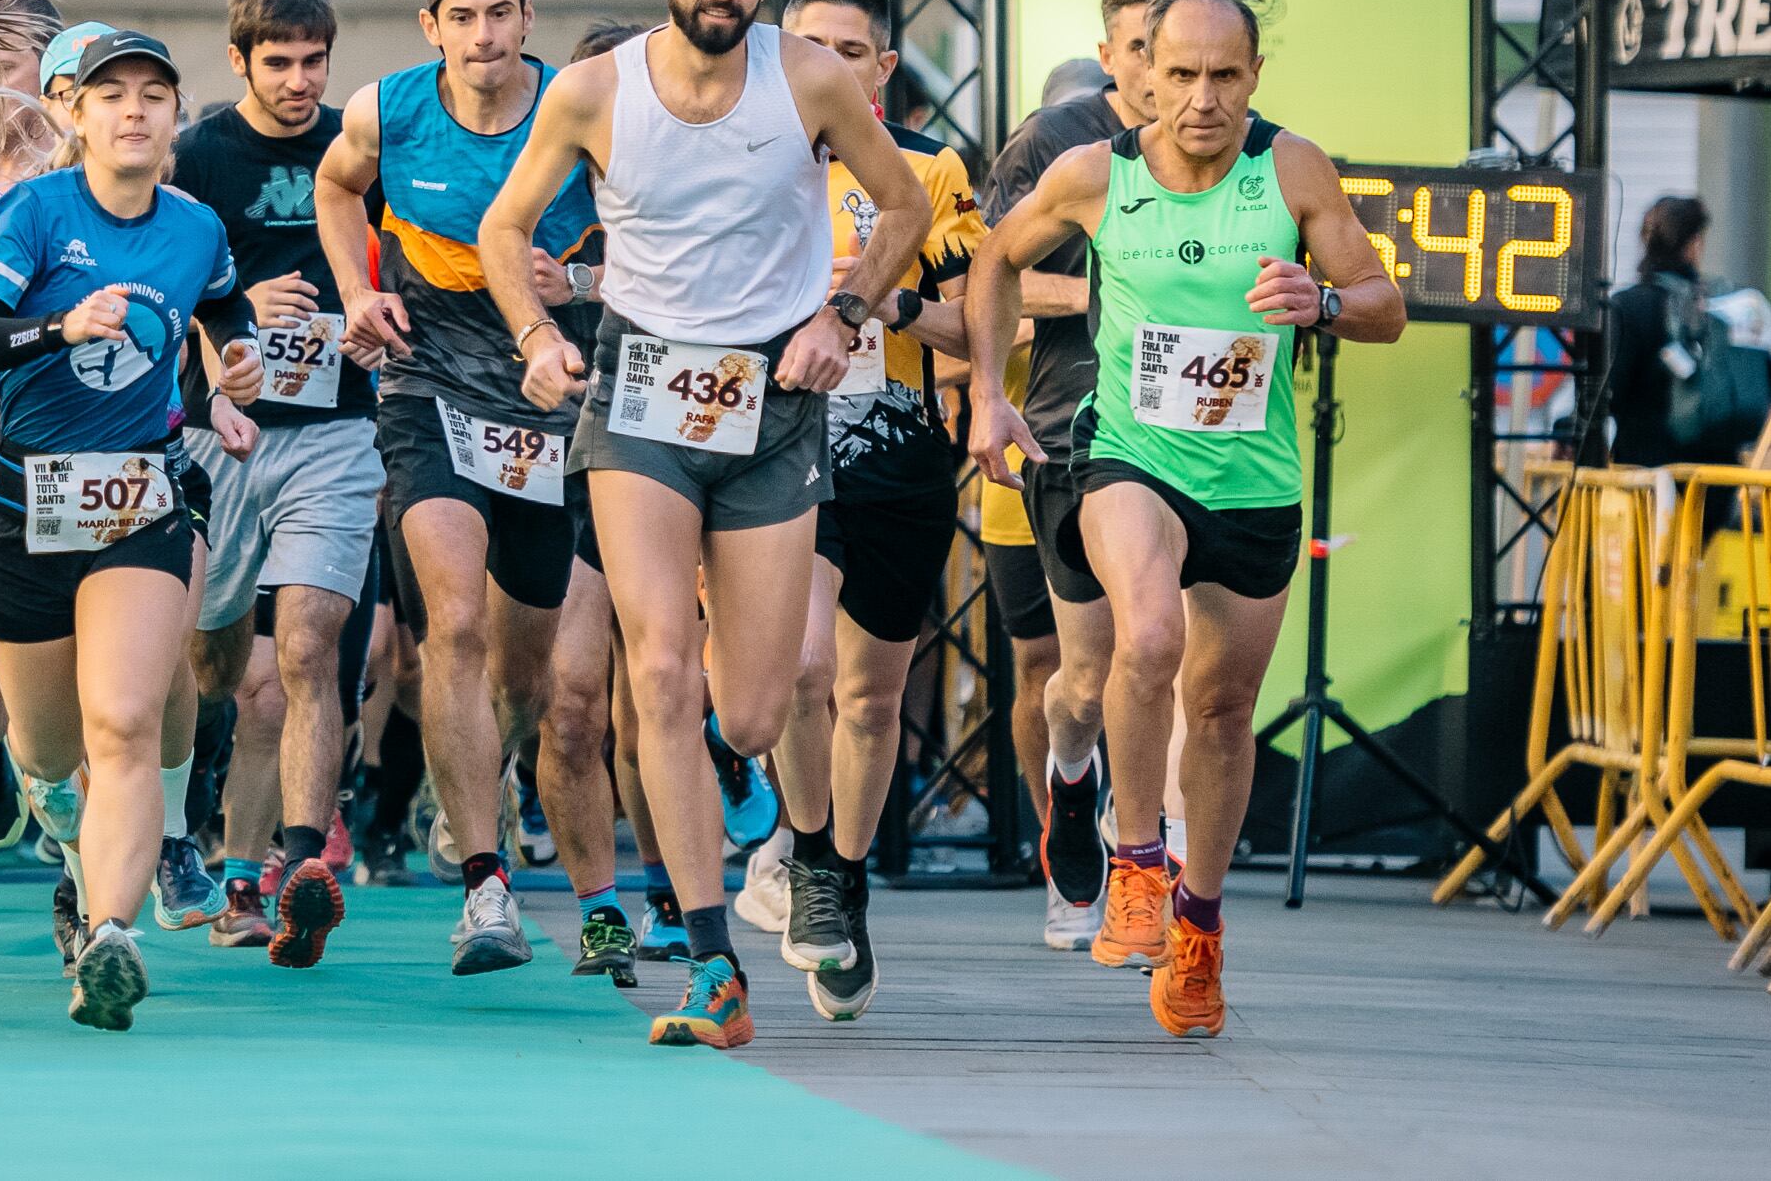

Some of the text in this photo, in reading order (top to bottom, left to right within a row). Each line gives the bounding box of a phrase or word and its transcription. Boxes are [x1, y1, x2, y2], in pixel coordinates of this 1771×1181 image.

[1209, 242, 1268, 256] correas
[105, 282, 165, 304] NNING
[168, 307, 183, 341] ONIL
[10, 327, 40, 348] 226ERS
[867, 335, 877, 351] 8K
[1143, 329, 1180, 344] VII TRAIL
[264, 332, 324, 366] 552
[645, 342, 669, 355] TRAIL
[1142, 341, 1174, 354] FIRA DE
[629, 351, 663, 365] FIRA DE
[1141, 351, 1162, 363] TOTS
[628, 362, 649, 374] TOTS
[1140, 362, 1168, 375] SANTS
[1180, 355, 1251, 389] 465
[274, 370, 310, 381] DARKO
[626, 373, 655, 386] SANTS
[668, 369, 743, 408] 436
[746, 394, 757, 410] 8K
[1196, 396, 1233, 407] RUBEN
[686, 411, 716, 425] RAFA
[483, 426, 546, 461] 549
[34, 461, 74, 473] VII AIL
[35, 473, 69, 483] FIRA DE
[36, 483, 58, 494] TOTS
[79, 478, 149, 512] 507
[36, 495, 65, 506] SANTS
[157, 492, 168, 508] 8K
[77, 517, 115, 529] MARÍA
